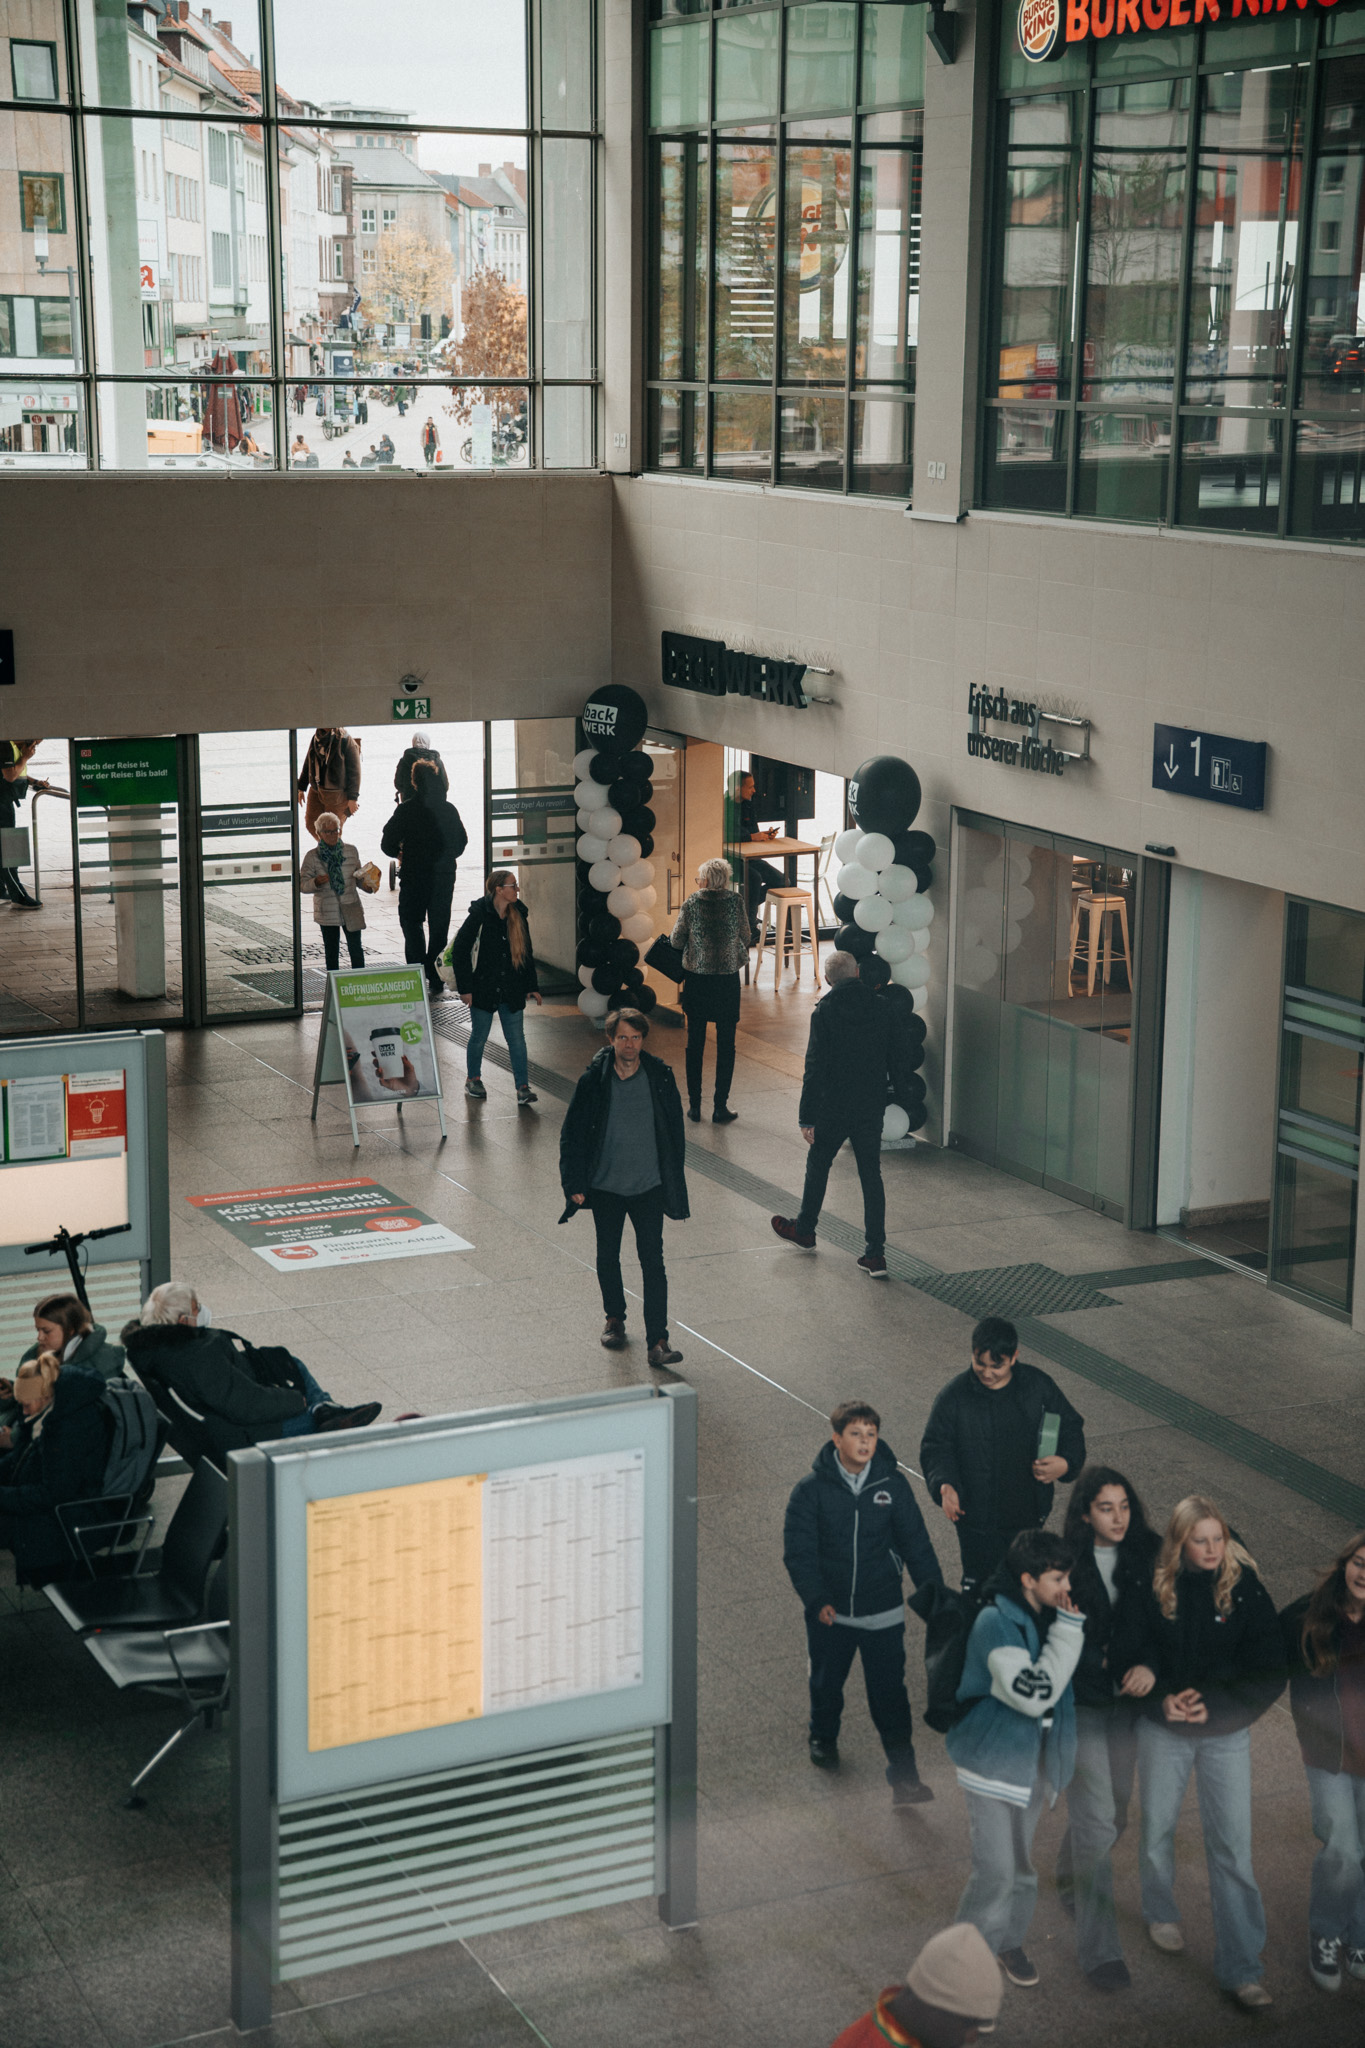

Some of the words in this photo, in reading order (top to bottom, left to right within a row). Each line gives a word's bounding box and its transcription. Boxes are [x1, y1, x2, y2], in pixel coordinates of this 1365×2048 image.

[1024, 5, 1055, 47] KING
[584, 704, 615, 722] back
[968, 682, 1008, 722] Frisch
[1011, 699, 1037, 728] aus
[584, 722, 616, 736] WERK
[967, 732, 1020, 766] unserer
[1020, 735, 1064, 776] Küche
[1190, 736, 1201, 777] 1
[81, 762, 100, 770] Nach
[102, 762, 115, 770] der
[117, 761, 138, 769] Reise
[148, 769, 168, 777] bald!
[521, 801, 534, 810] bye!
[232, 815, 278, 825] Wiedersehen!
[204, 1193, 259, 1202] Ausbildung
[217, 1192, 382, 1215] Karriereschritt
[265, 1198, 391, 1217] Finanzamt!
[323, 1237, 391, 1248] Finanzamt
[328, 1235, 446, 1252] Hildesheim-Alfeld
